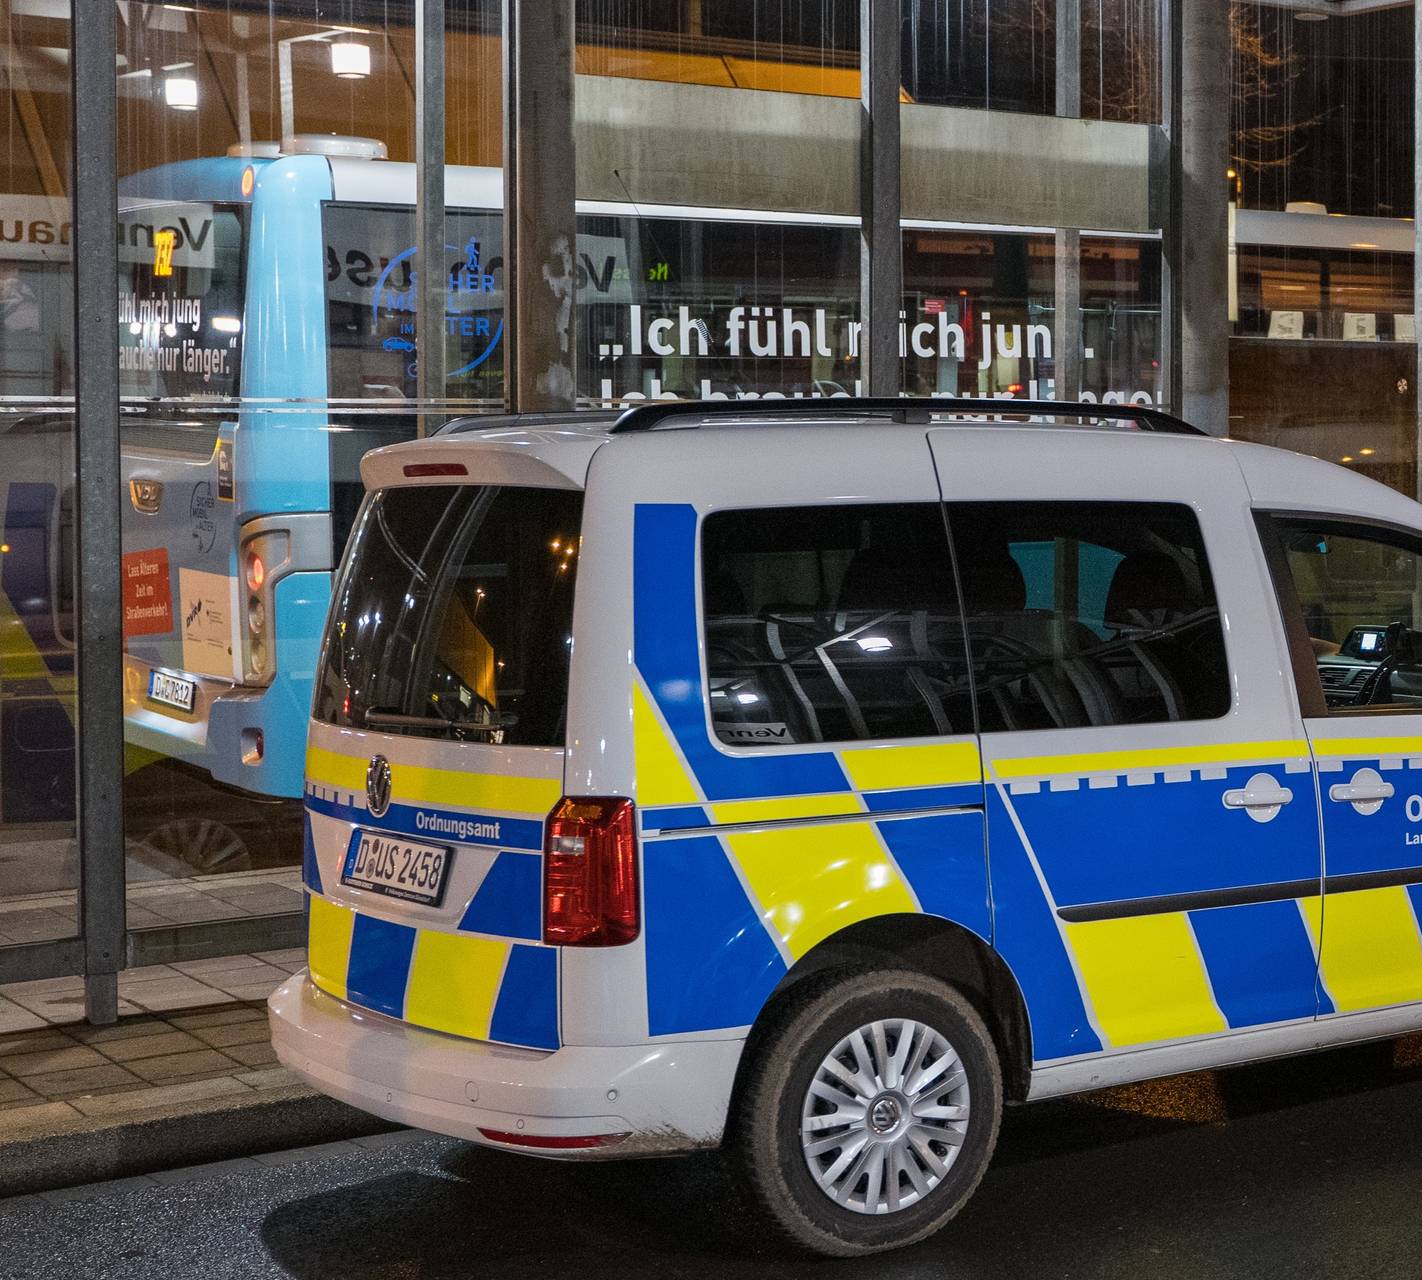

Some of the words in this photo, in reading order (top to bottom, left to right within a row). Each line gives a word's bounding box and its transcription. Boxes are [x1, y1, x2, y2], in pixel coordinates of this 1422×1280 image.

[140, 292, 169, 323] mich
[172, 292, 200, 332] jung
[600, 304, 709, 361] „Ich
[726, 306, 832, 357] fühl
[978, 312, 1094, 370] jun.
[158, 347, 180, 372] nur
[416, 811, 501, 839] Ordnungsamt
[355, 839, 370, 874] D
[375, 842, 399, 880] US
[397, 848, 442, 890] 2458
